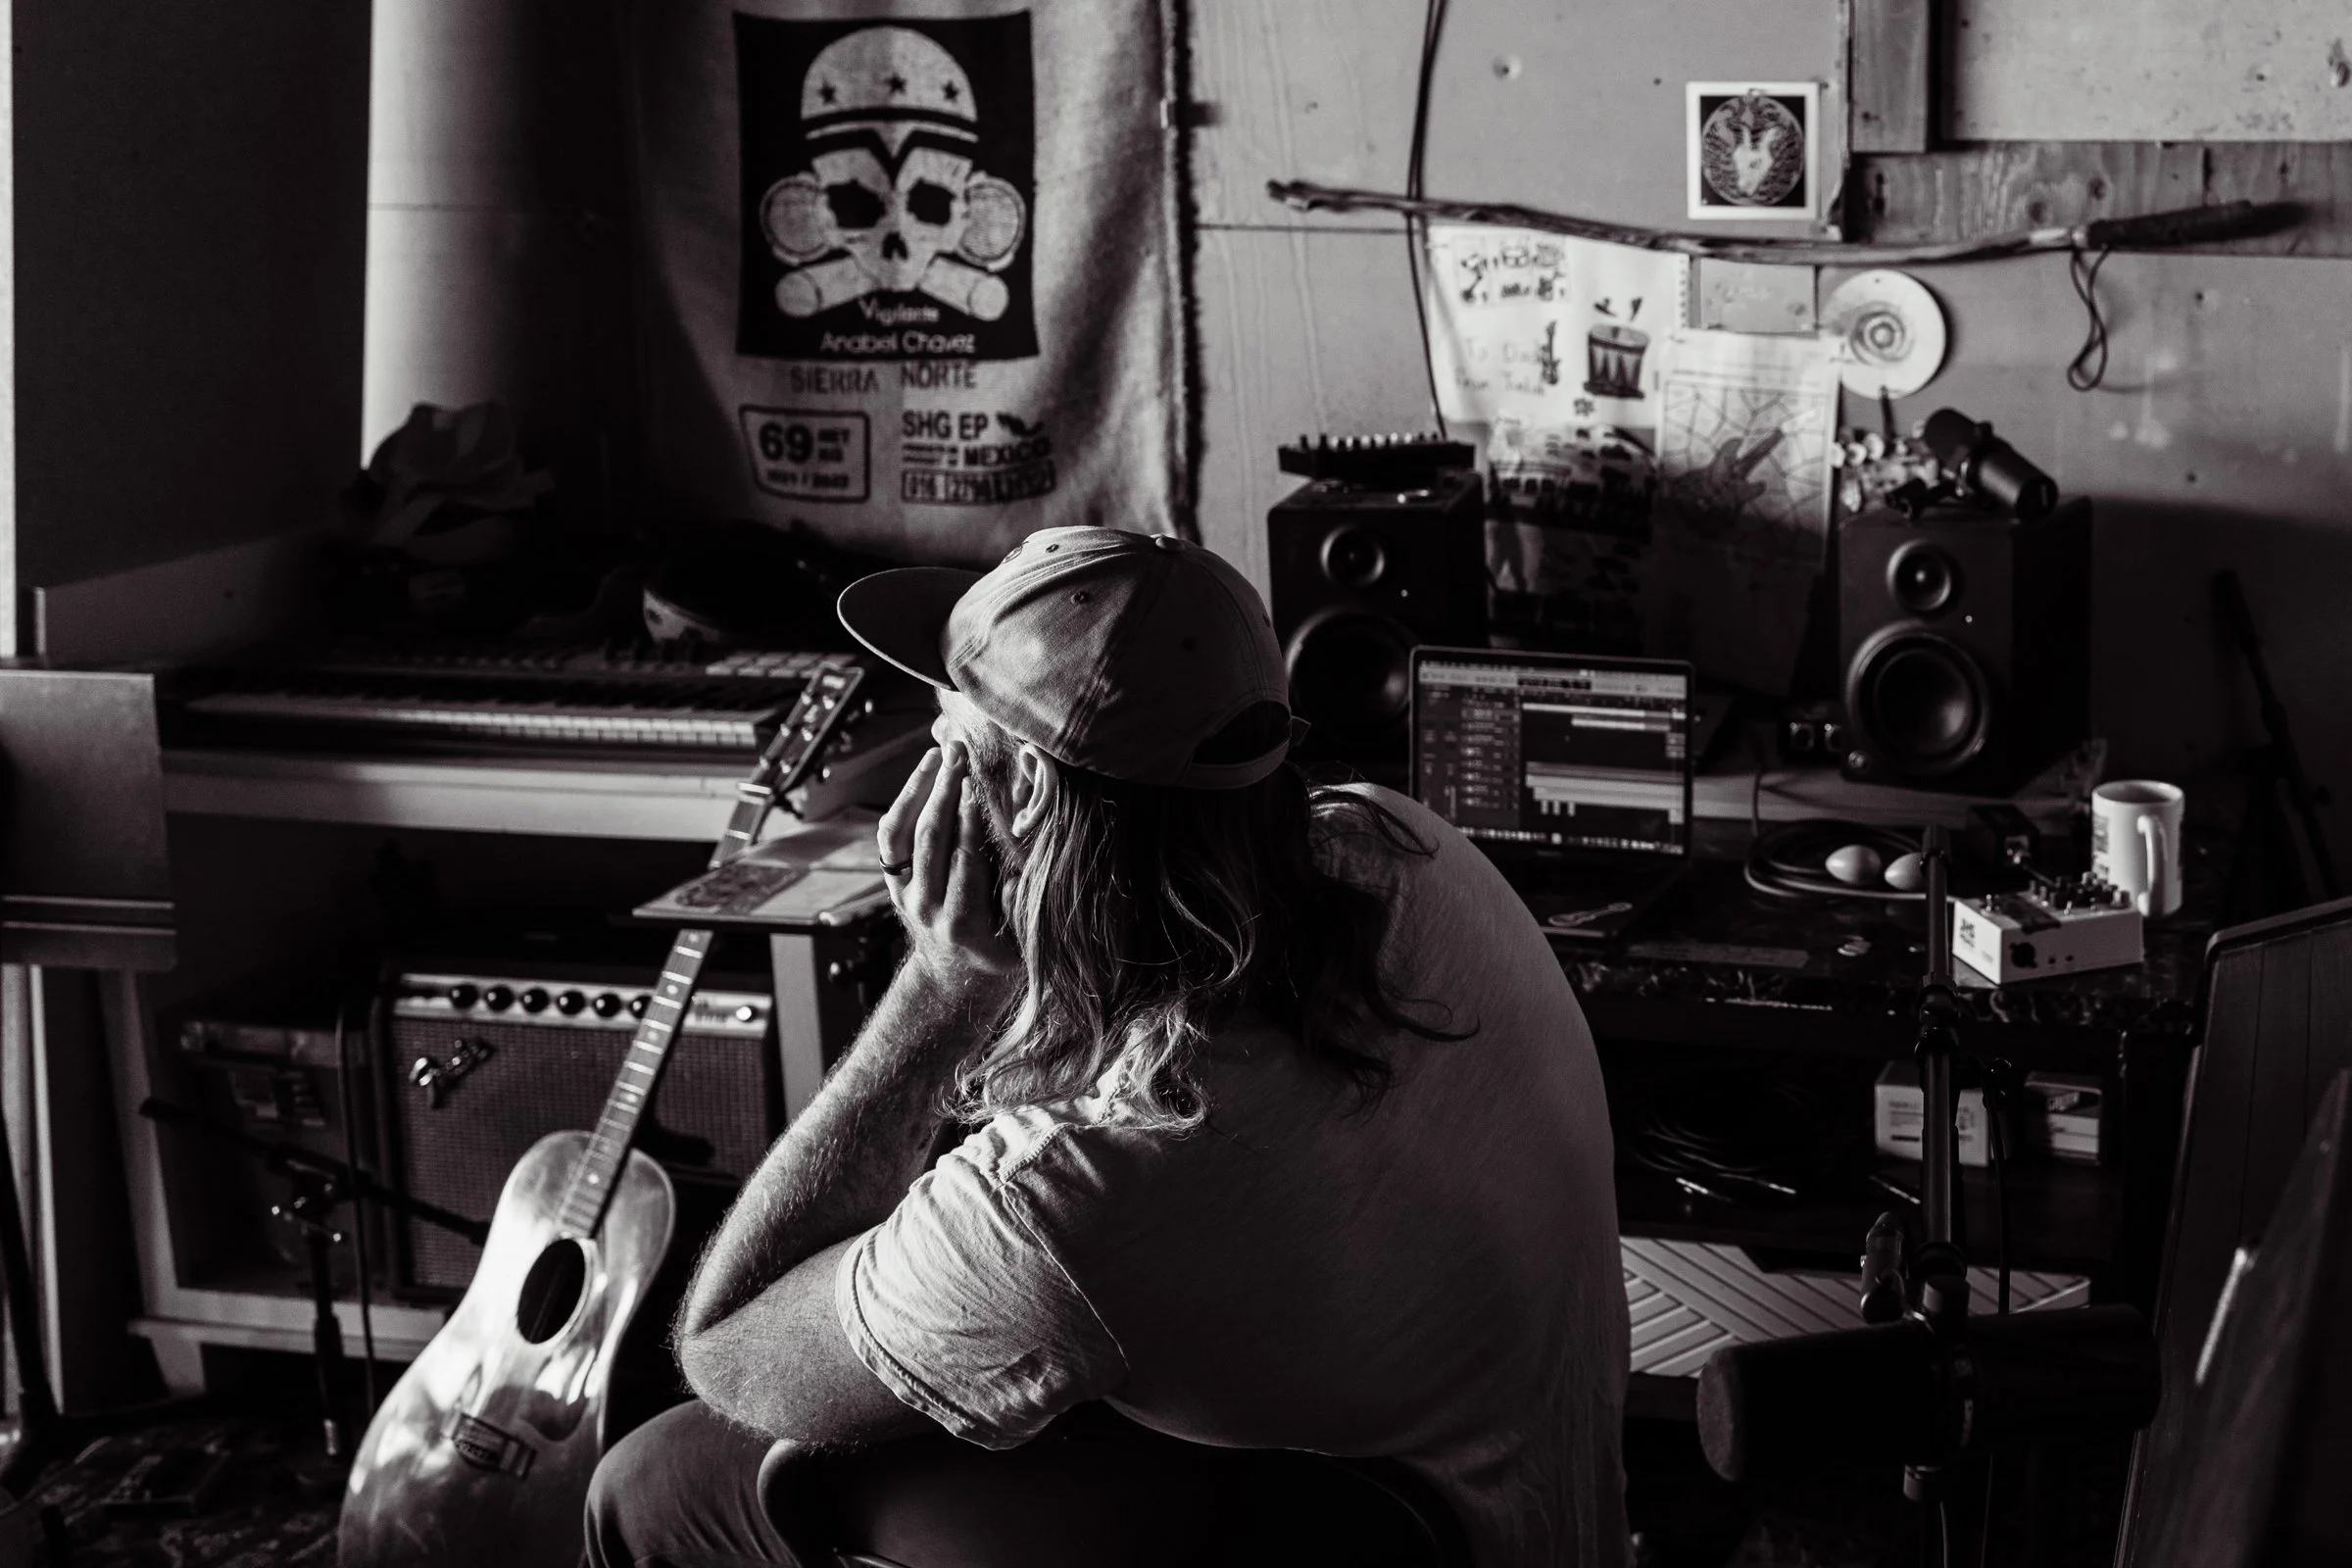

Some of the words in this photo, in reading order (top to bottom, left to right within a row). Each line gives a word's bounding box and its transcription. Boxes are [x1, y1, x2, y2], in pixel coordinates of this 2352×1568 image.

[858, 297, 941, 326] Vigilante
[820, 330, 898, 354] Anabel
[902, 330, 976, 354] Chavez
[790, 367, 879, 394] SIERRA
[900, 363, 978, 389] NORTE
[902, 410, 951, 439] SHG
[959, 412, 988, 440] EP
[760, 421, 813, 465] 69
[964, 436, 1053, 466] MEXICO
